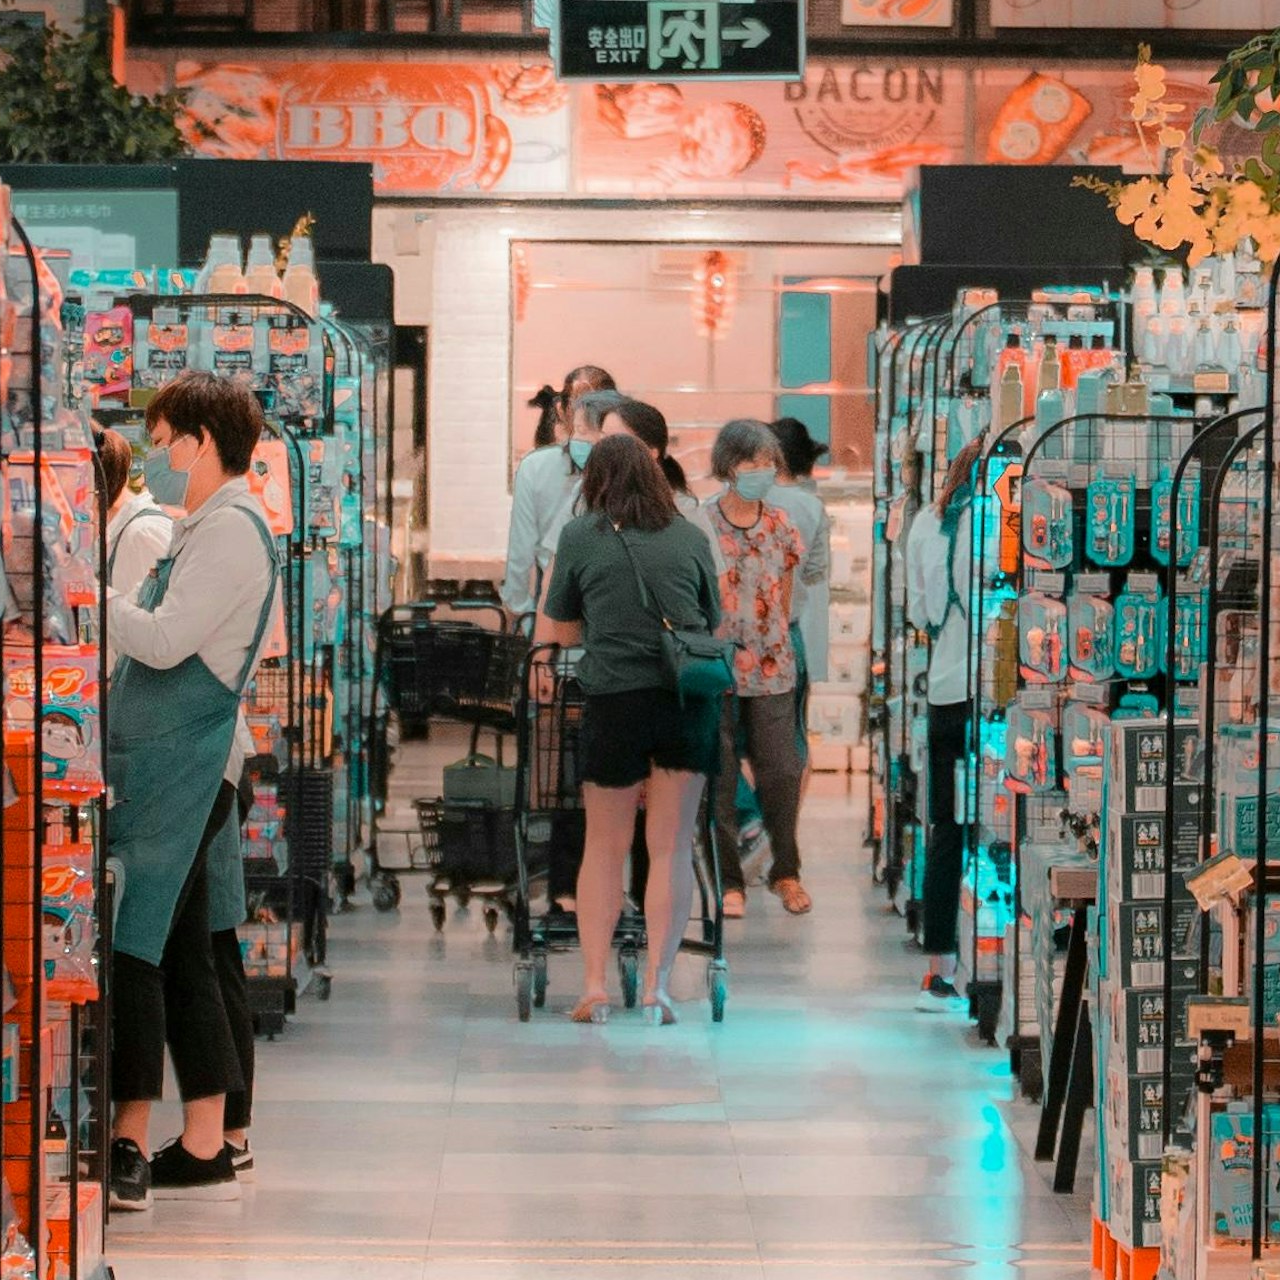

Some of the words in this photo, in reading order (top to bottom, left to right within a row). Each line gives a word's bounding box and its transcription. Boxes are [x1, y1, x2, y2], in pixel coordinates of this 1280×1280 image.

[588, 27, 646, 49] 安全出口
[596, 51, 640, 63] EXIT
[784, 67, 943, 104] BACON
[287, 104, 470, 154] BBQ
